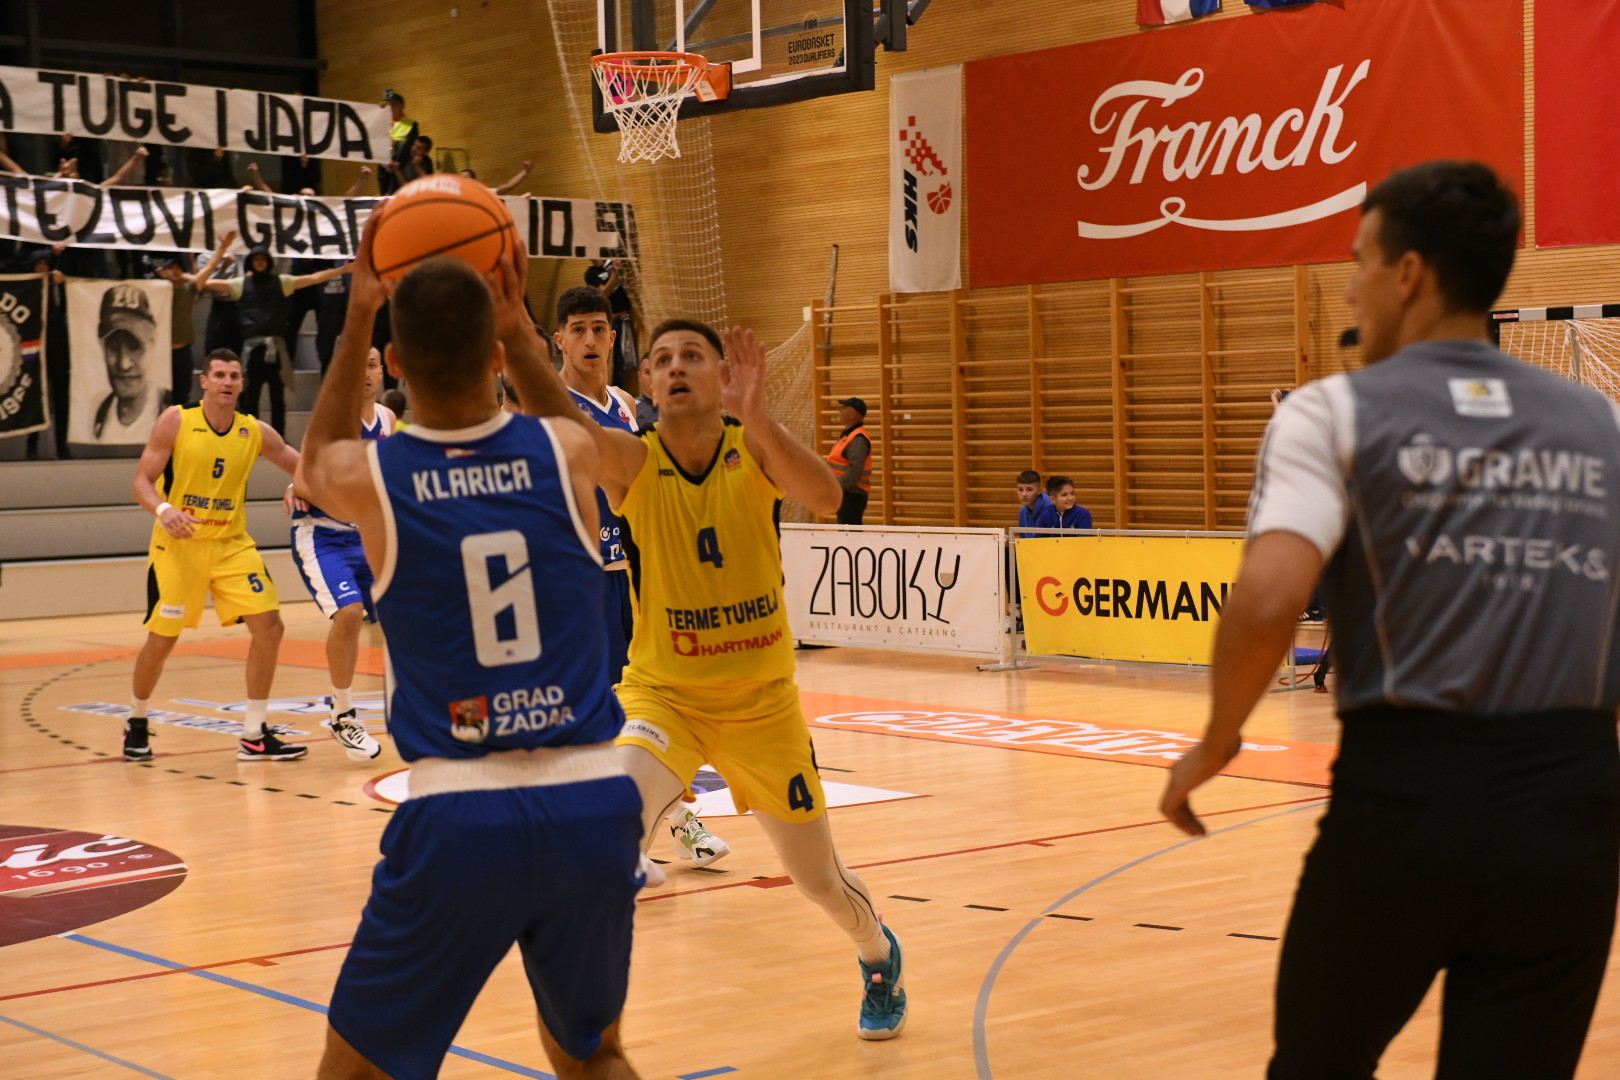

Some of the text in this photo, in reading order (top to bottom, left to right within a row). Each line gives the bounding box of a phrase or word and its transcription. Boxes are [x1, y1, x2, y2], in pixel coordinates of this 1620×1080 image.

[788, 33, 835, 54] EUROBASKET
[788, 48, 836, 65] 2023 QUALIFIERS
[37, 71, 193, 144] TUGE
[216, 90, 227, 148] I
[245, 93, 373, 160] JADA
[903, 168, 918, 254] HKS
[212, 458, 225, 479] 5
[412, 458, 533, 503] KLARICA
[1456, 447, 1606, 498] GRAWE
[697, 526, 724, 568] 4
[248, 573, 264, 593] 5
[810, 546, 961, 624] ZABOKY
[665, 606, 721, 631] TERME
[810, 621, 877, 632] RESTAURANT
[899, 627, 956, 637] CATERING
[493, 685, 564, 714] GRAD
[495, 705, 576, 737] ZADAR
[814, 711, 1206, 759] CEDEVIT
[788, 772, 814, 813] 4
